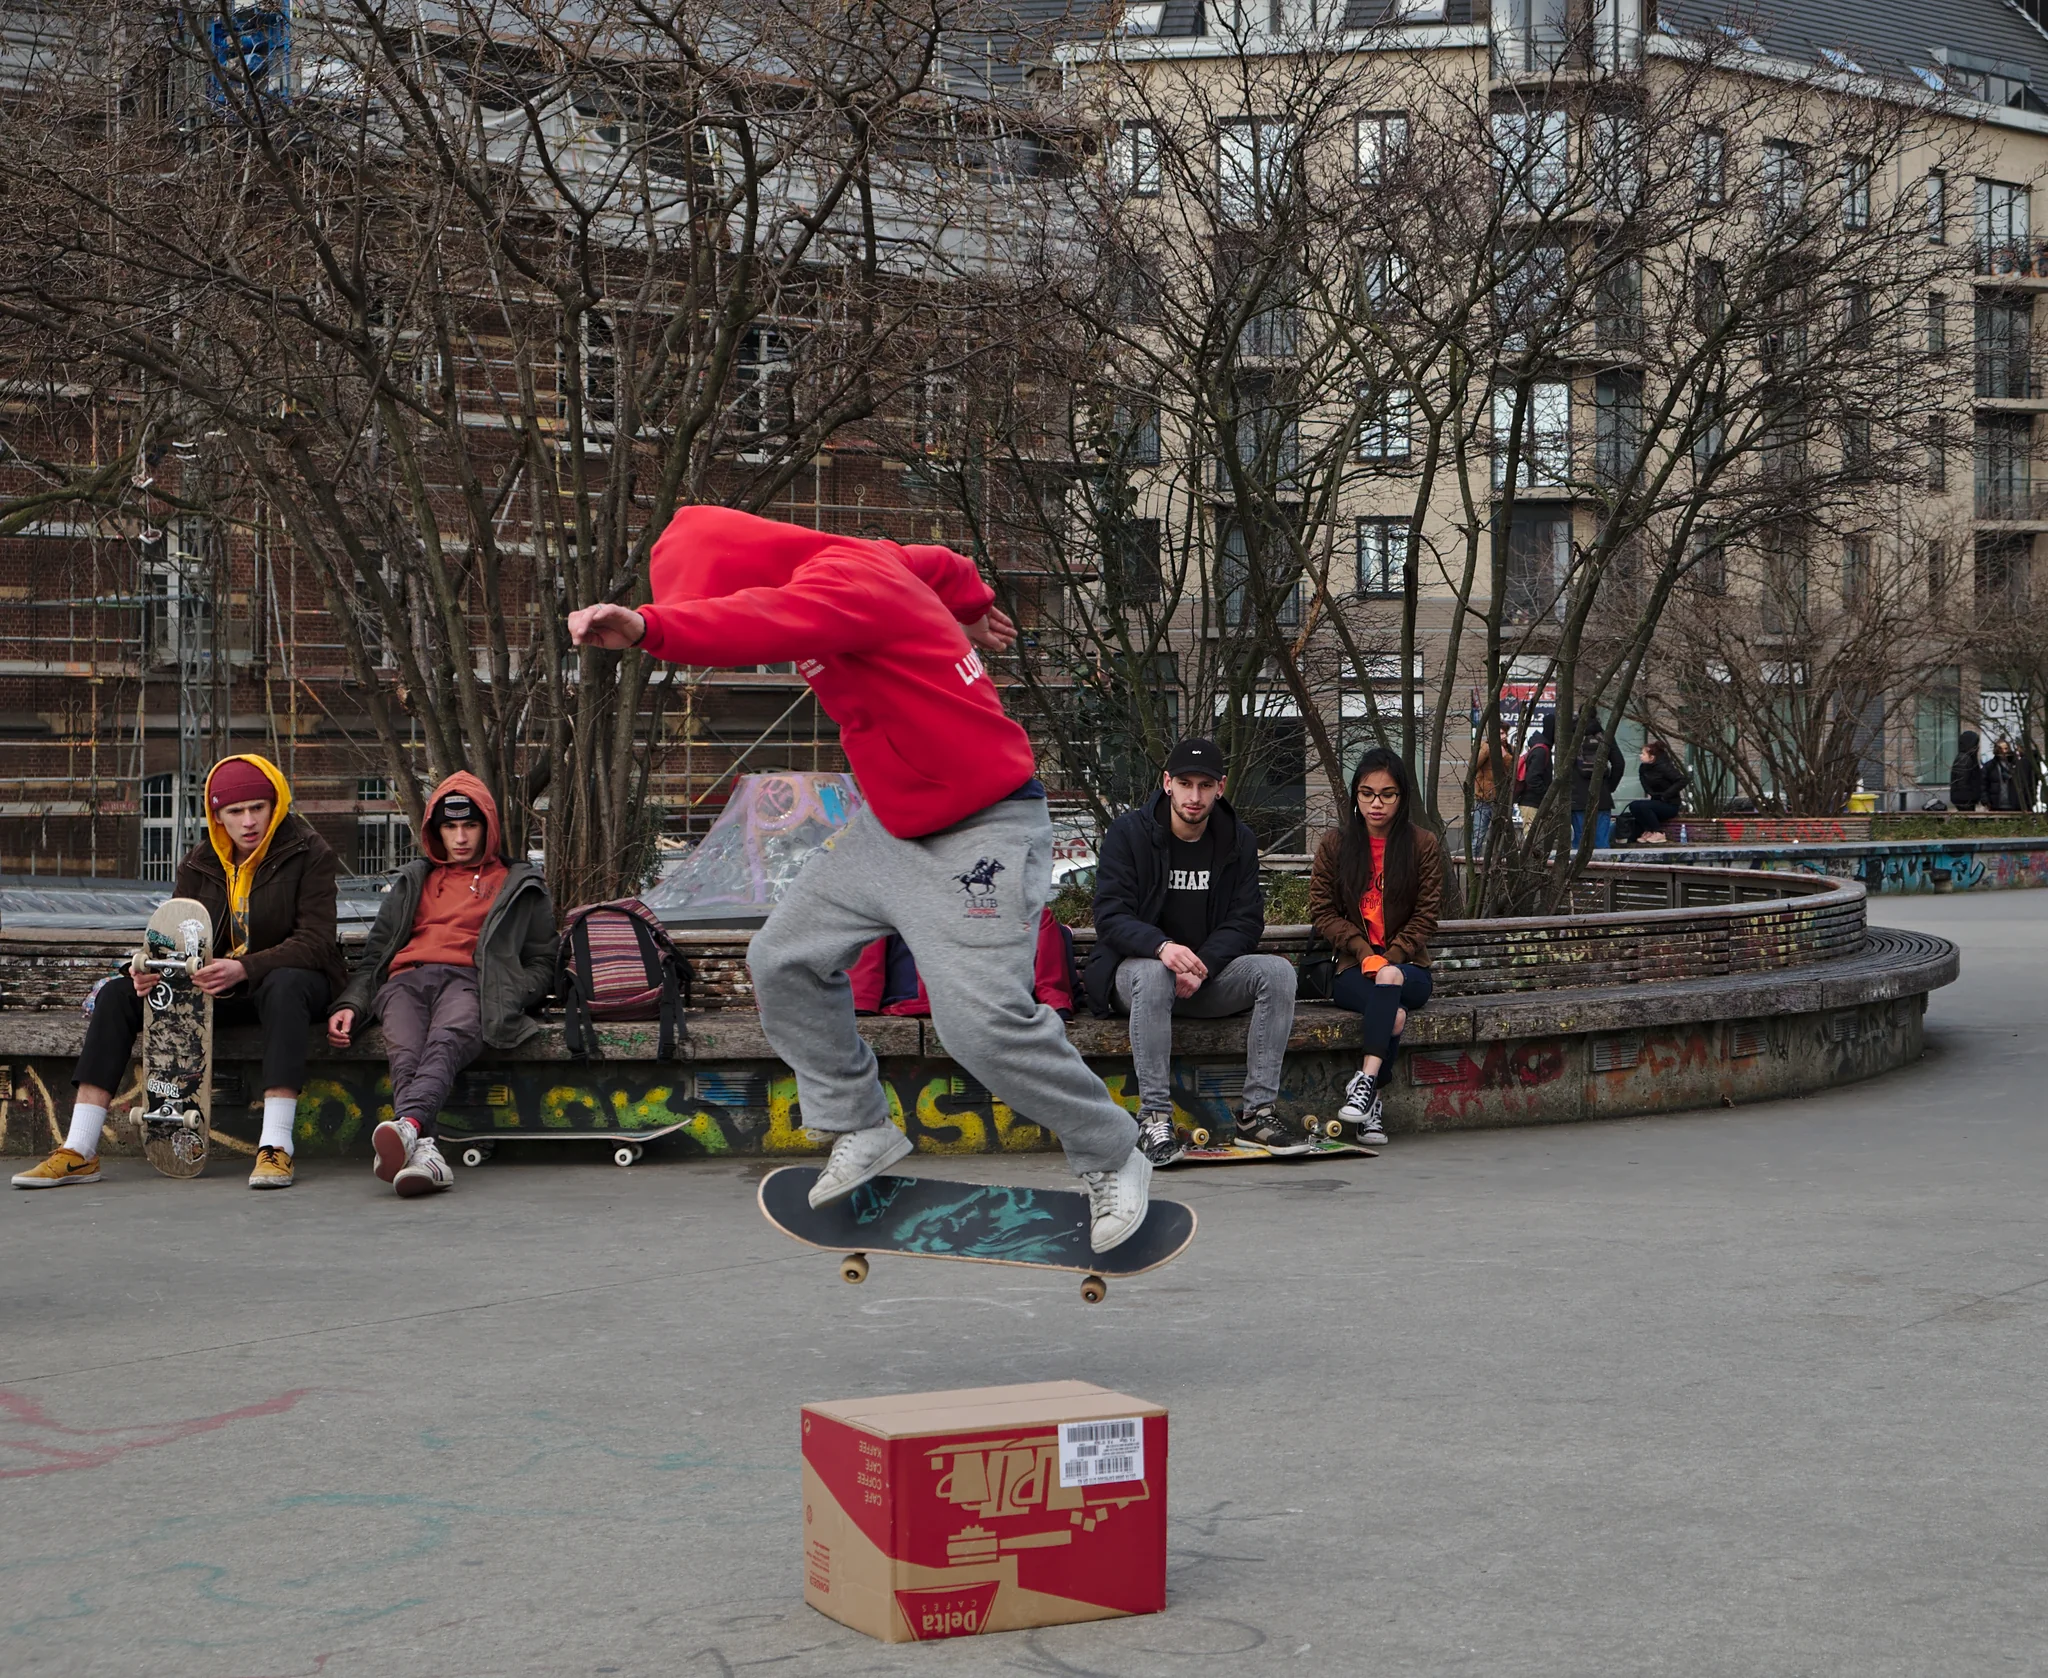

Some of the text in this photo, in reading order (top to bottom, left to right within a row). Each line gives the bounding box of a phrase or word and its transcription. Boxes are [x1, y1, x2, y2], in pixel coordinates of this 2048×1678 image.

[1979, 695, 1998, 712] TO
[858, 1440, 882, 1458] KAFFEE
[857, 1472, 882, 1490] COFFEE
[865, 1491, 882, 1506] CAFÉ
[922, 1599, 977, 1612] CAFÉS
[922, 1609, 977, 1634] Delta
